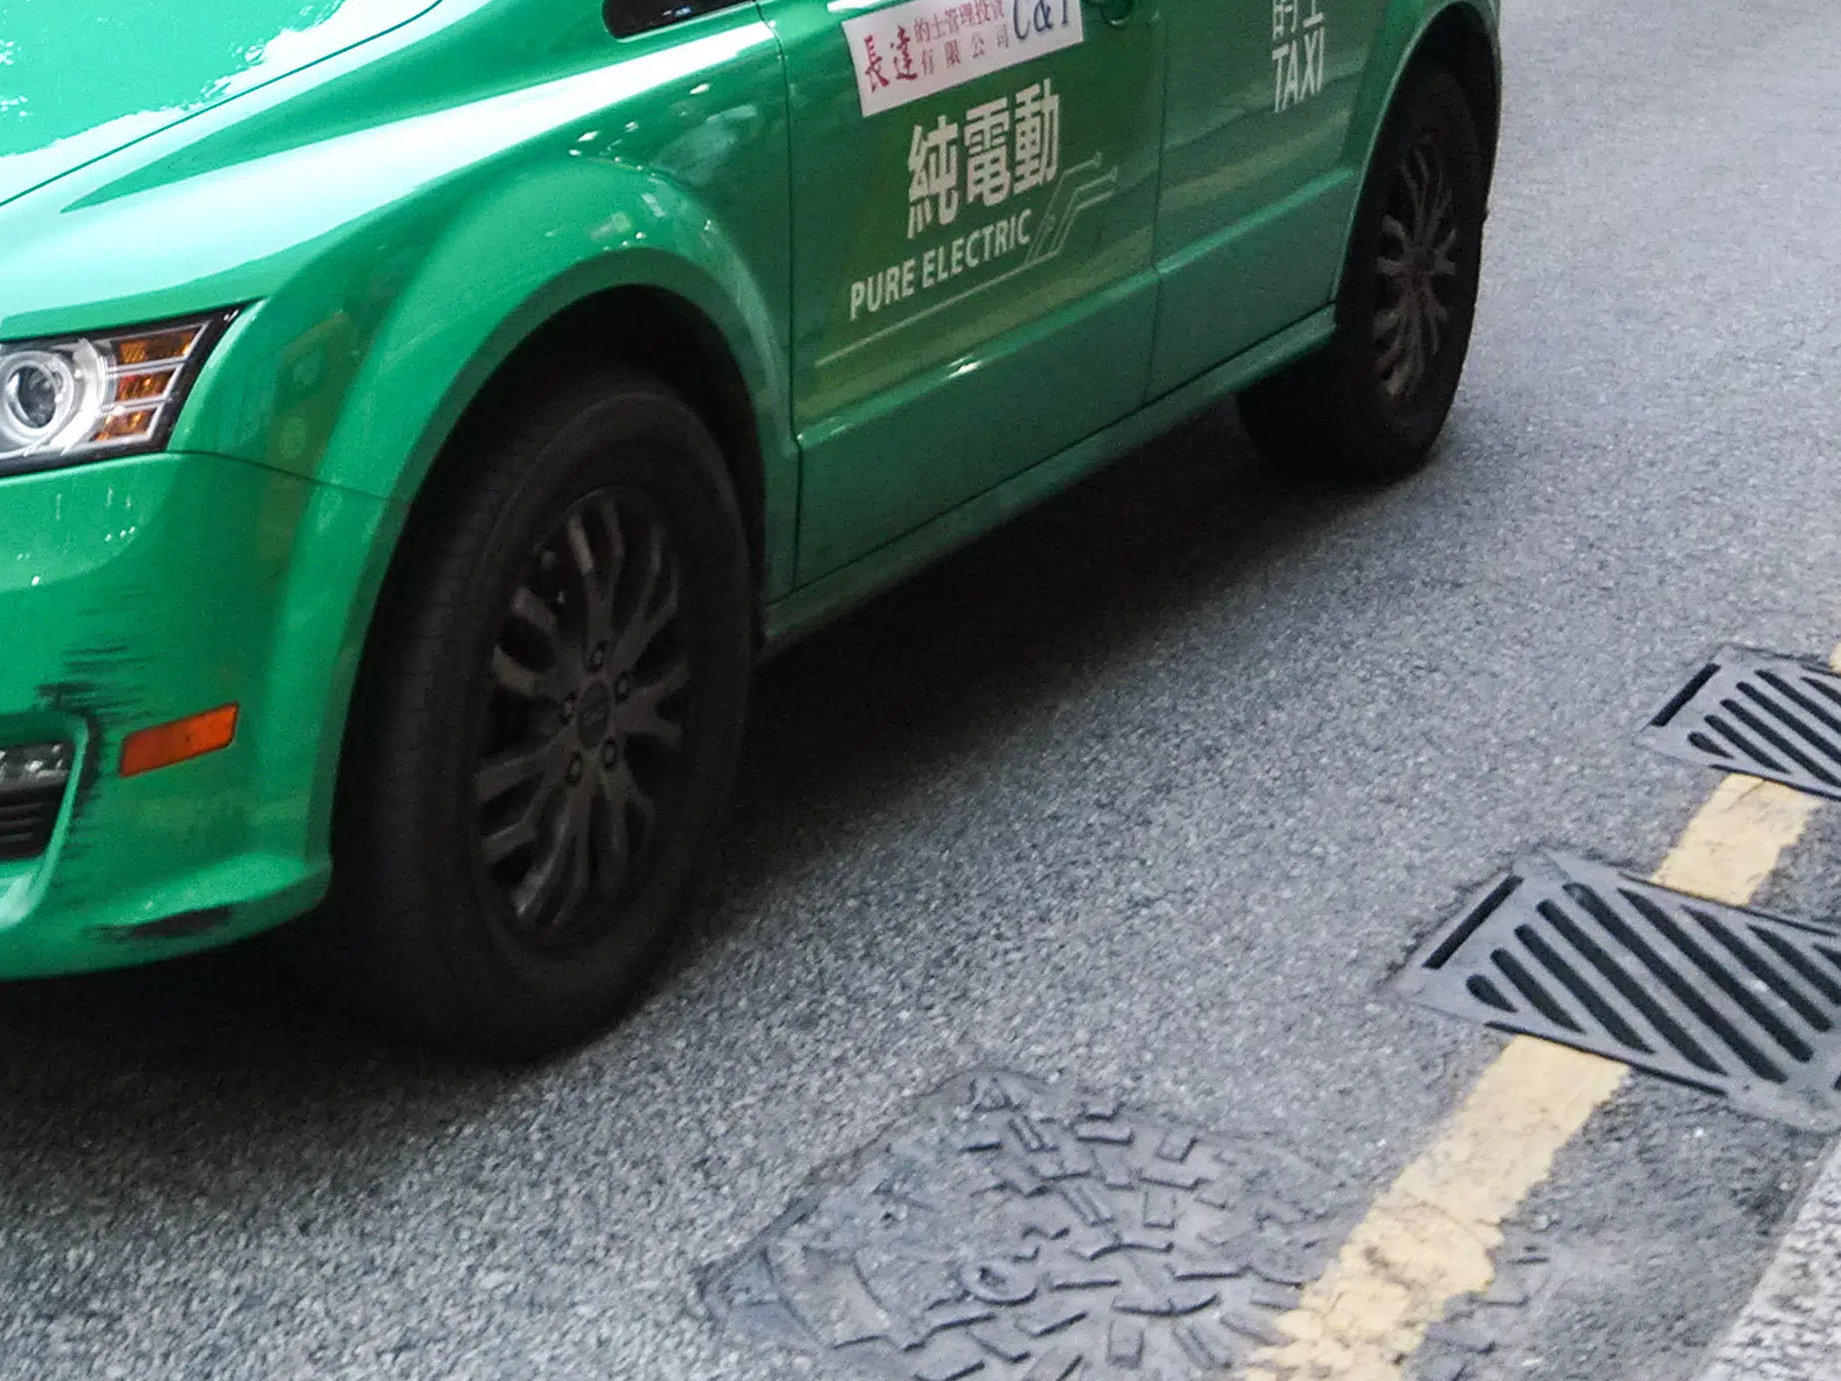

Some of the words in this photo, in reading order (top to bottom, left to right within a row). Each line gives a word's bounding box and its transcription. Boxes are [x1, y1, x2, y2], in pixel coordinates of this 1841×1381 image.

[862, 25, 918, 93] 長達
[919, 24, 1010, 77] 有限公司
[1271, 26, 1325, 114] TAXI
[907, 77, 1060, 240] 純電動
[850, 259, 916, 321] PURE
[922, 209, 1032, 288] ELECTRIC
